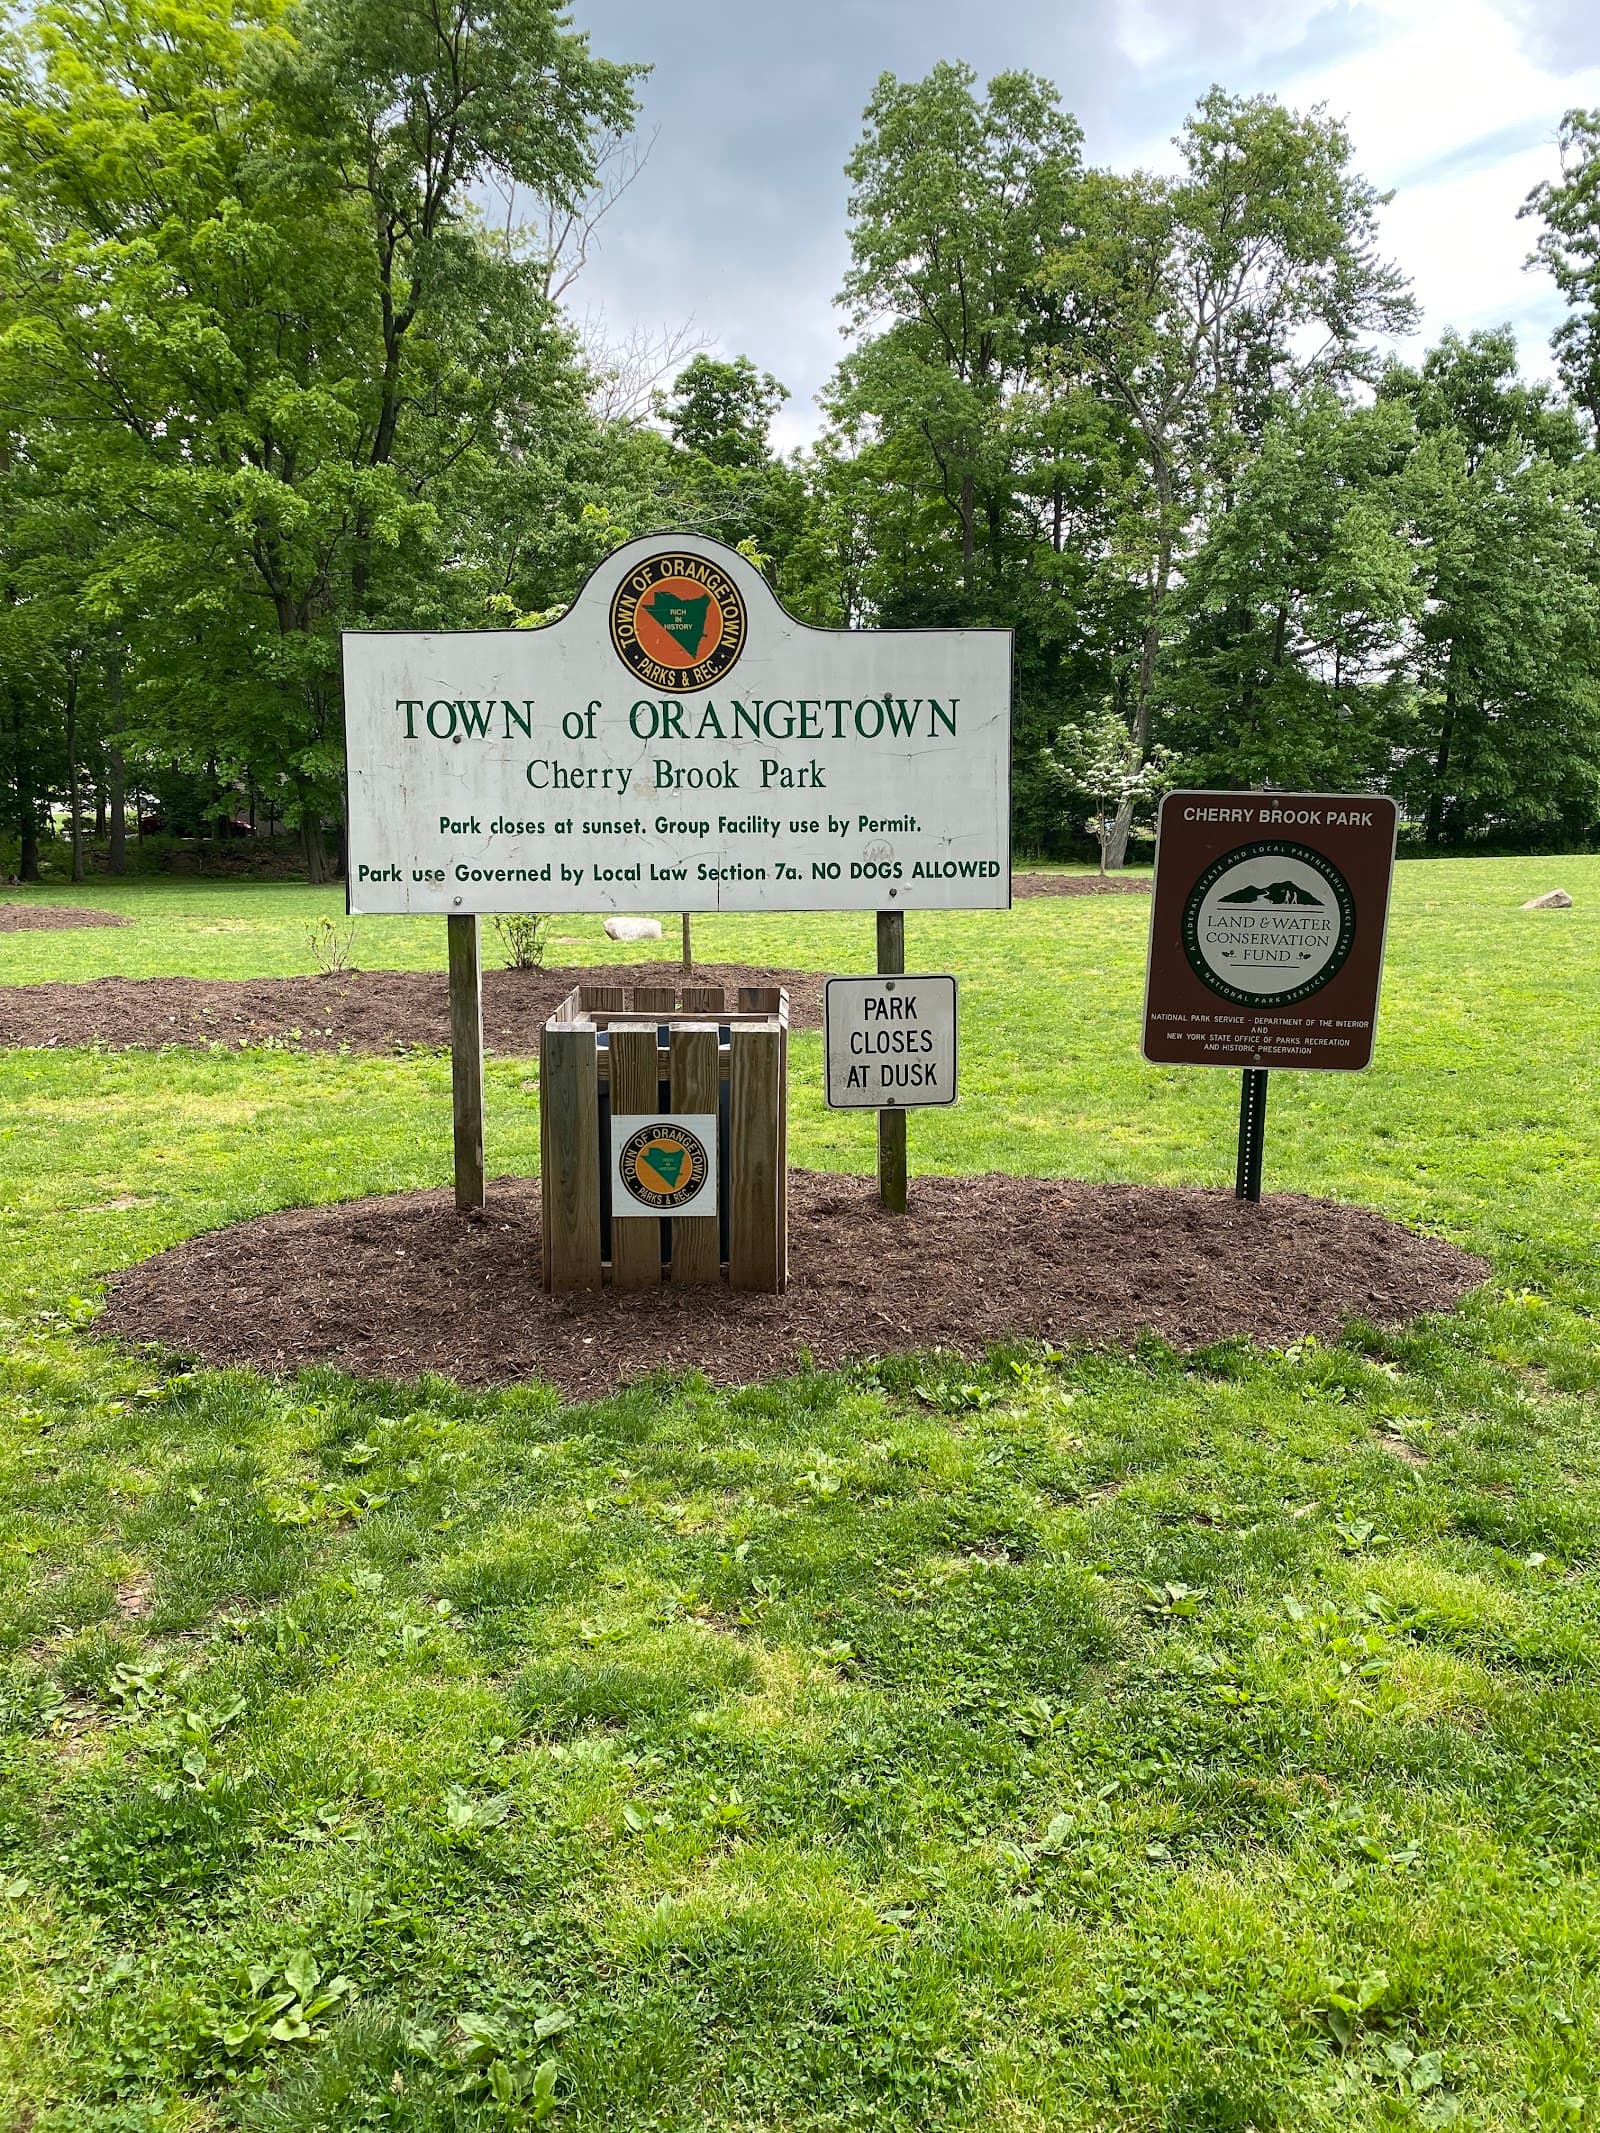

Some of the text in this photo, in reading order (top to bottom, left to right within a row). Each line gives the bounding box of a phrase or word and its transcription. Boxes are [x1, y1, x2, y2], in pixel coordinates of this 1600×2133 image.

[617, 560, 740, 649] TOWN OF ORANGETOWN
[637, 658, 722, 687] PARKS & REC.
[396, 699, 960, 740] TOWN of ORANGETOWN
[526, 759, 826, 796] Cherry Brook Park
[440, 814, 922, 838] Park closes at sunset. Group Facility use by Permit.
[1183, 808, 1373, 826] CHERRY BROOK PARK
[358, 860, 1001, 886] Park use Governed by Local Law Section 7a. NO DOGS ALLOWED
[1200, 865, 1223, 891] STATE
[1227, 851, 1247, 865] AND
[1252, 845, 1286, 854] LOCAL
[1291, 848, 1345, 893] PARTNERSHIP
[1343, 898, 1351, 927] SINCE
[1207, 916, 1332, 931] LAND & WATER
[1206, 932, 1330, 947] CONSERVATION
[1243, 950, 1291, 962] FUND
[1204, 972, 1249, 1002] NATIONAL
[1287, 975, 1325, 1001] SERVICE
[864, 997, 918, 1021] PARK
[1151, 1013, 1187, 1021] NATIONAL
[1191, 1014, 1211, 1022] PARK
[1336, 1020, 1369, 1028] INTERIOR
[850, 1030, 933, 1054] CLOSES
[1186, 1033, 1206, 1041] YORK
[1209, 1034, 1231, 1042] STATE
[1234, 1035, 1260, 1043] OFFICE
[1263, 1036, 1273, 1044] OF
[1304, 1037, 1350, 1046] RECREATION
[1258, 1046, 1312, 1054] PRESERVATION
[847, 1063, 937, 1088] AT DUSK
[624, 1149, 638, 1182] TOWN
[634, 1132, 650, 1148] OF
[652, 1128, 704, 1182] ORANGETOWN
[637, 1187, 693, 1205] PARKS & REC.
